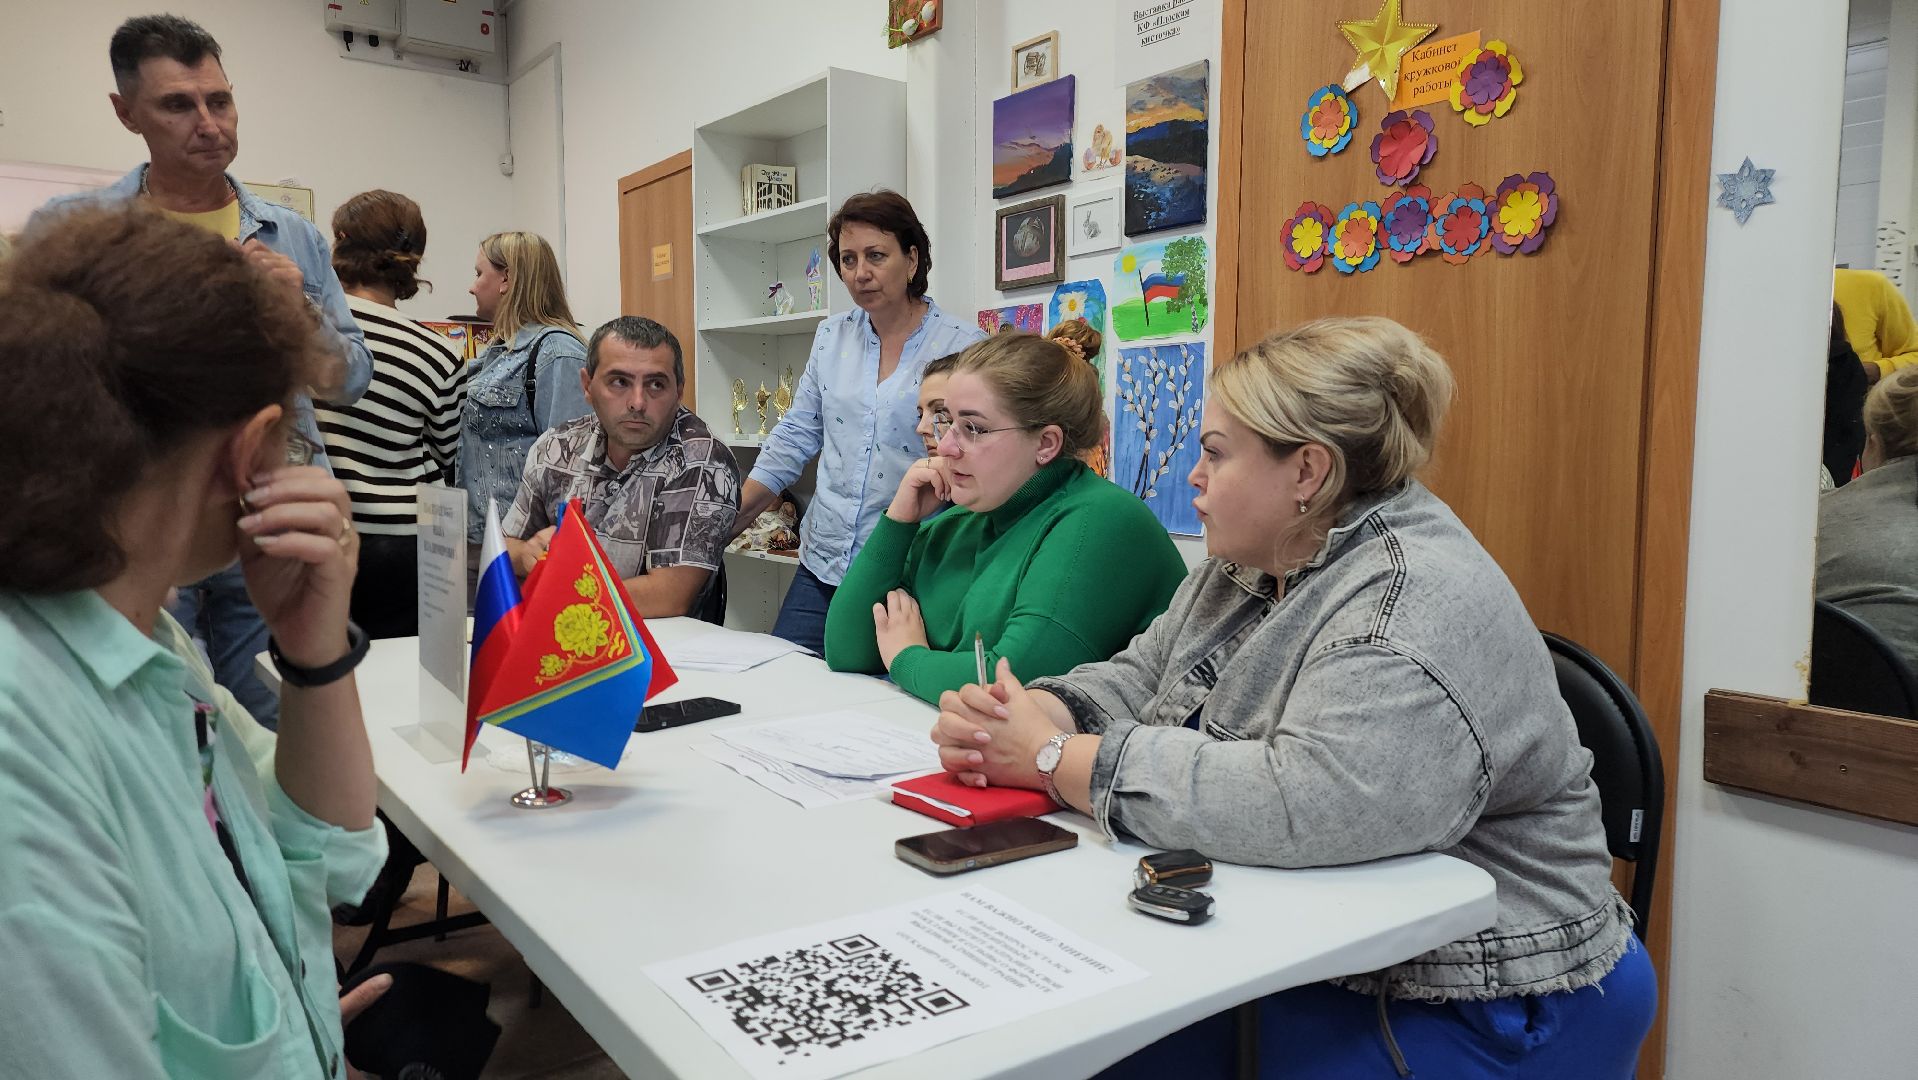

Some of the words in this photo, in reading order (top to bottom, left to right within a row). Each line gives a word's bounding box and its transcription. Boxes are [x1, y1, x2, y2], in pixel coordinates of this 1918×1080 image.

[1133, 1, 1171, 20] Выставка
[1137, 21, 1150, 33] КФ
[1152, 8, 1190, 27] «Плоская
[1141, 26, 1181, 45] кисточка»
[1411, 44, 1457, 62] Кабинет
[1413, 79, 1452, 98] работы
